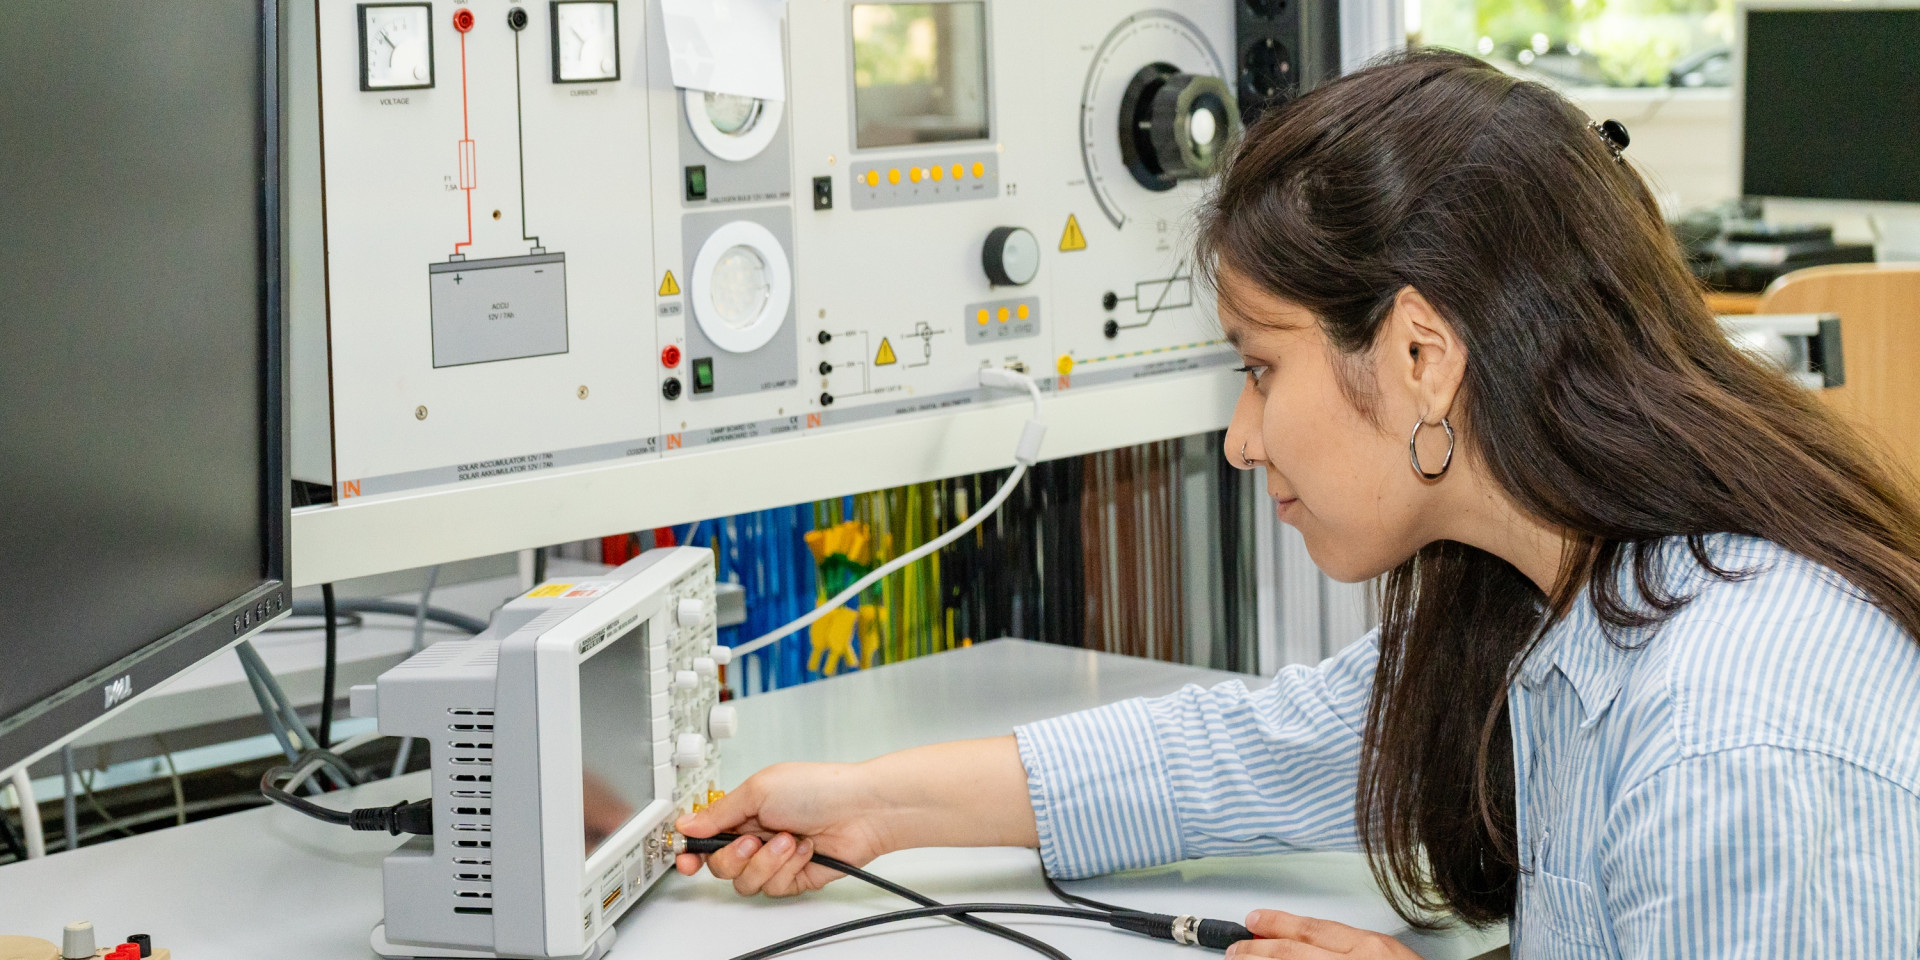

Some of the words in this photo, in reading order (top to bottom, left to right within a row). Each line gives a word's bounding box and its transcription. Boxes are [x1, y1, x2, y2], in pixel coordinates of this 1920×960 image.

[379, 97, 410, 106] VOLTAGE
[570, 89, 598, 97] CURRENT
[491, 302, 510, 310] ACCU
[488, 313, 499, 321] 12V
[666, 432, 682, 450] LN
[457, 463, 479, 472] SOLAR
[480, 456, 527, 469] ACCUMULATOR
[527, 454, 538, 462] 12V
[458, 471, 480, 481] SOLAR
[480, 464, 527, 477] AKKUMULATOR
[527, 462, 538, 471] 12V
[342, 478, 361, 499] LN
[104, 674, 133, 710] DELL
